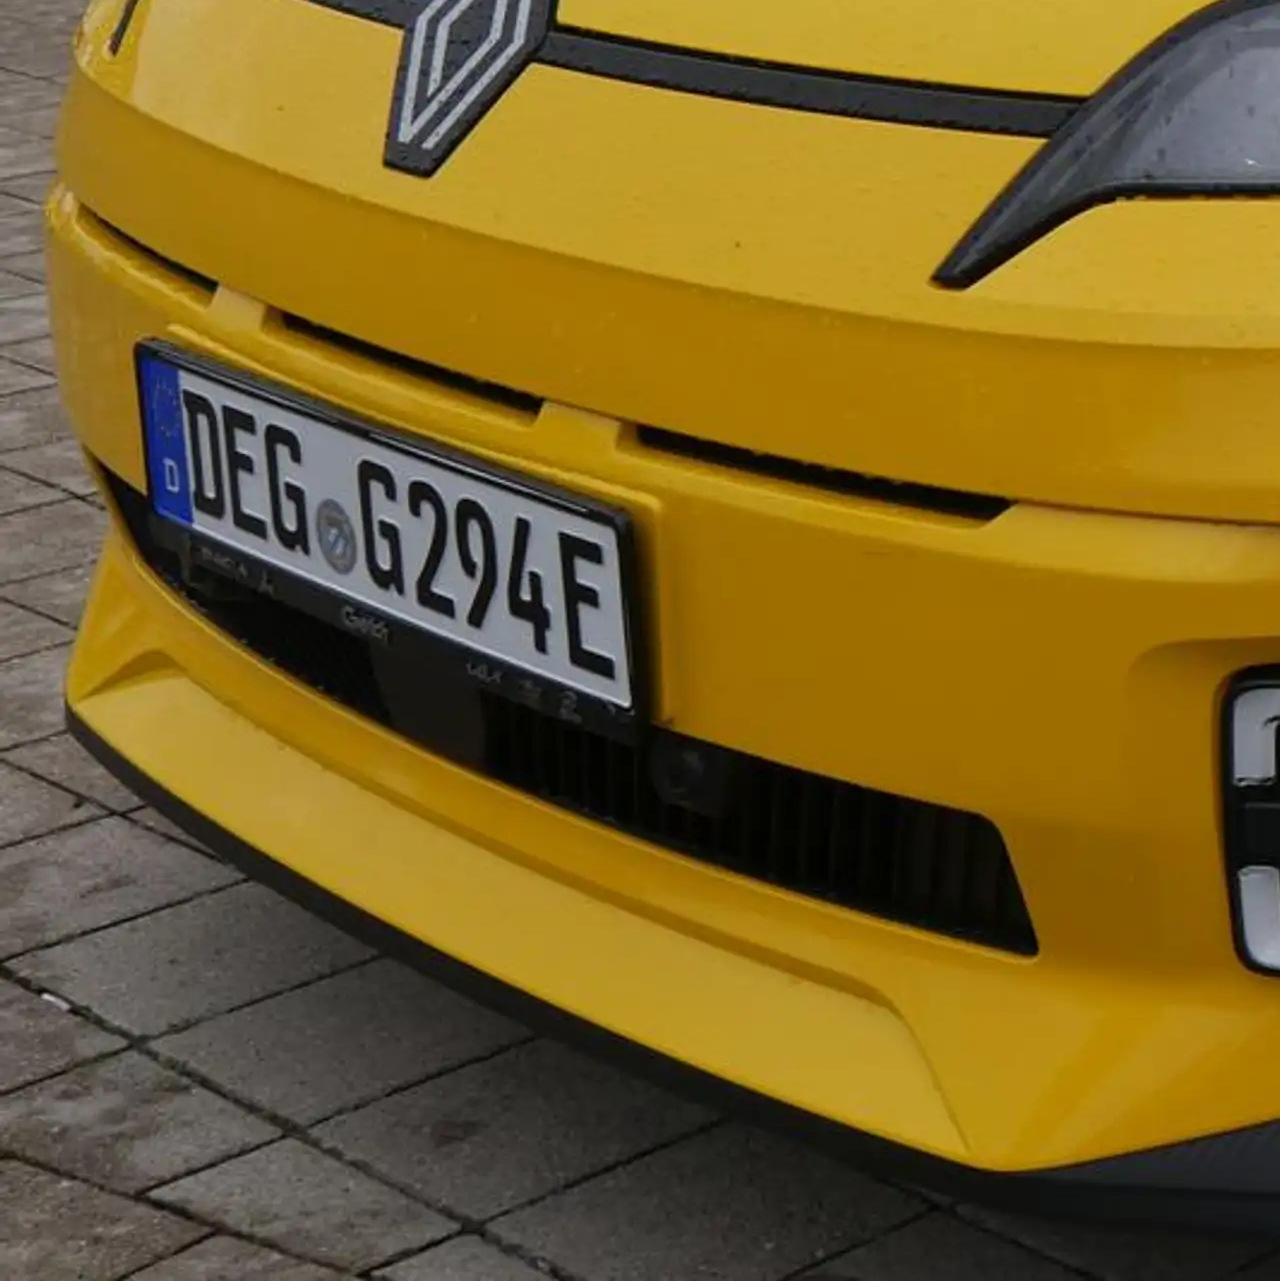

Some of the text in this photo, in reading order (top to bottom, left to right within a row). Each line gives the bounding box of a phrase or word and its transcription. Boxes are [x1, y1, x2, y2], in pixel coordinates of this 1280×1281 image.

[163, 389, 619, 679] D DEG G294E
